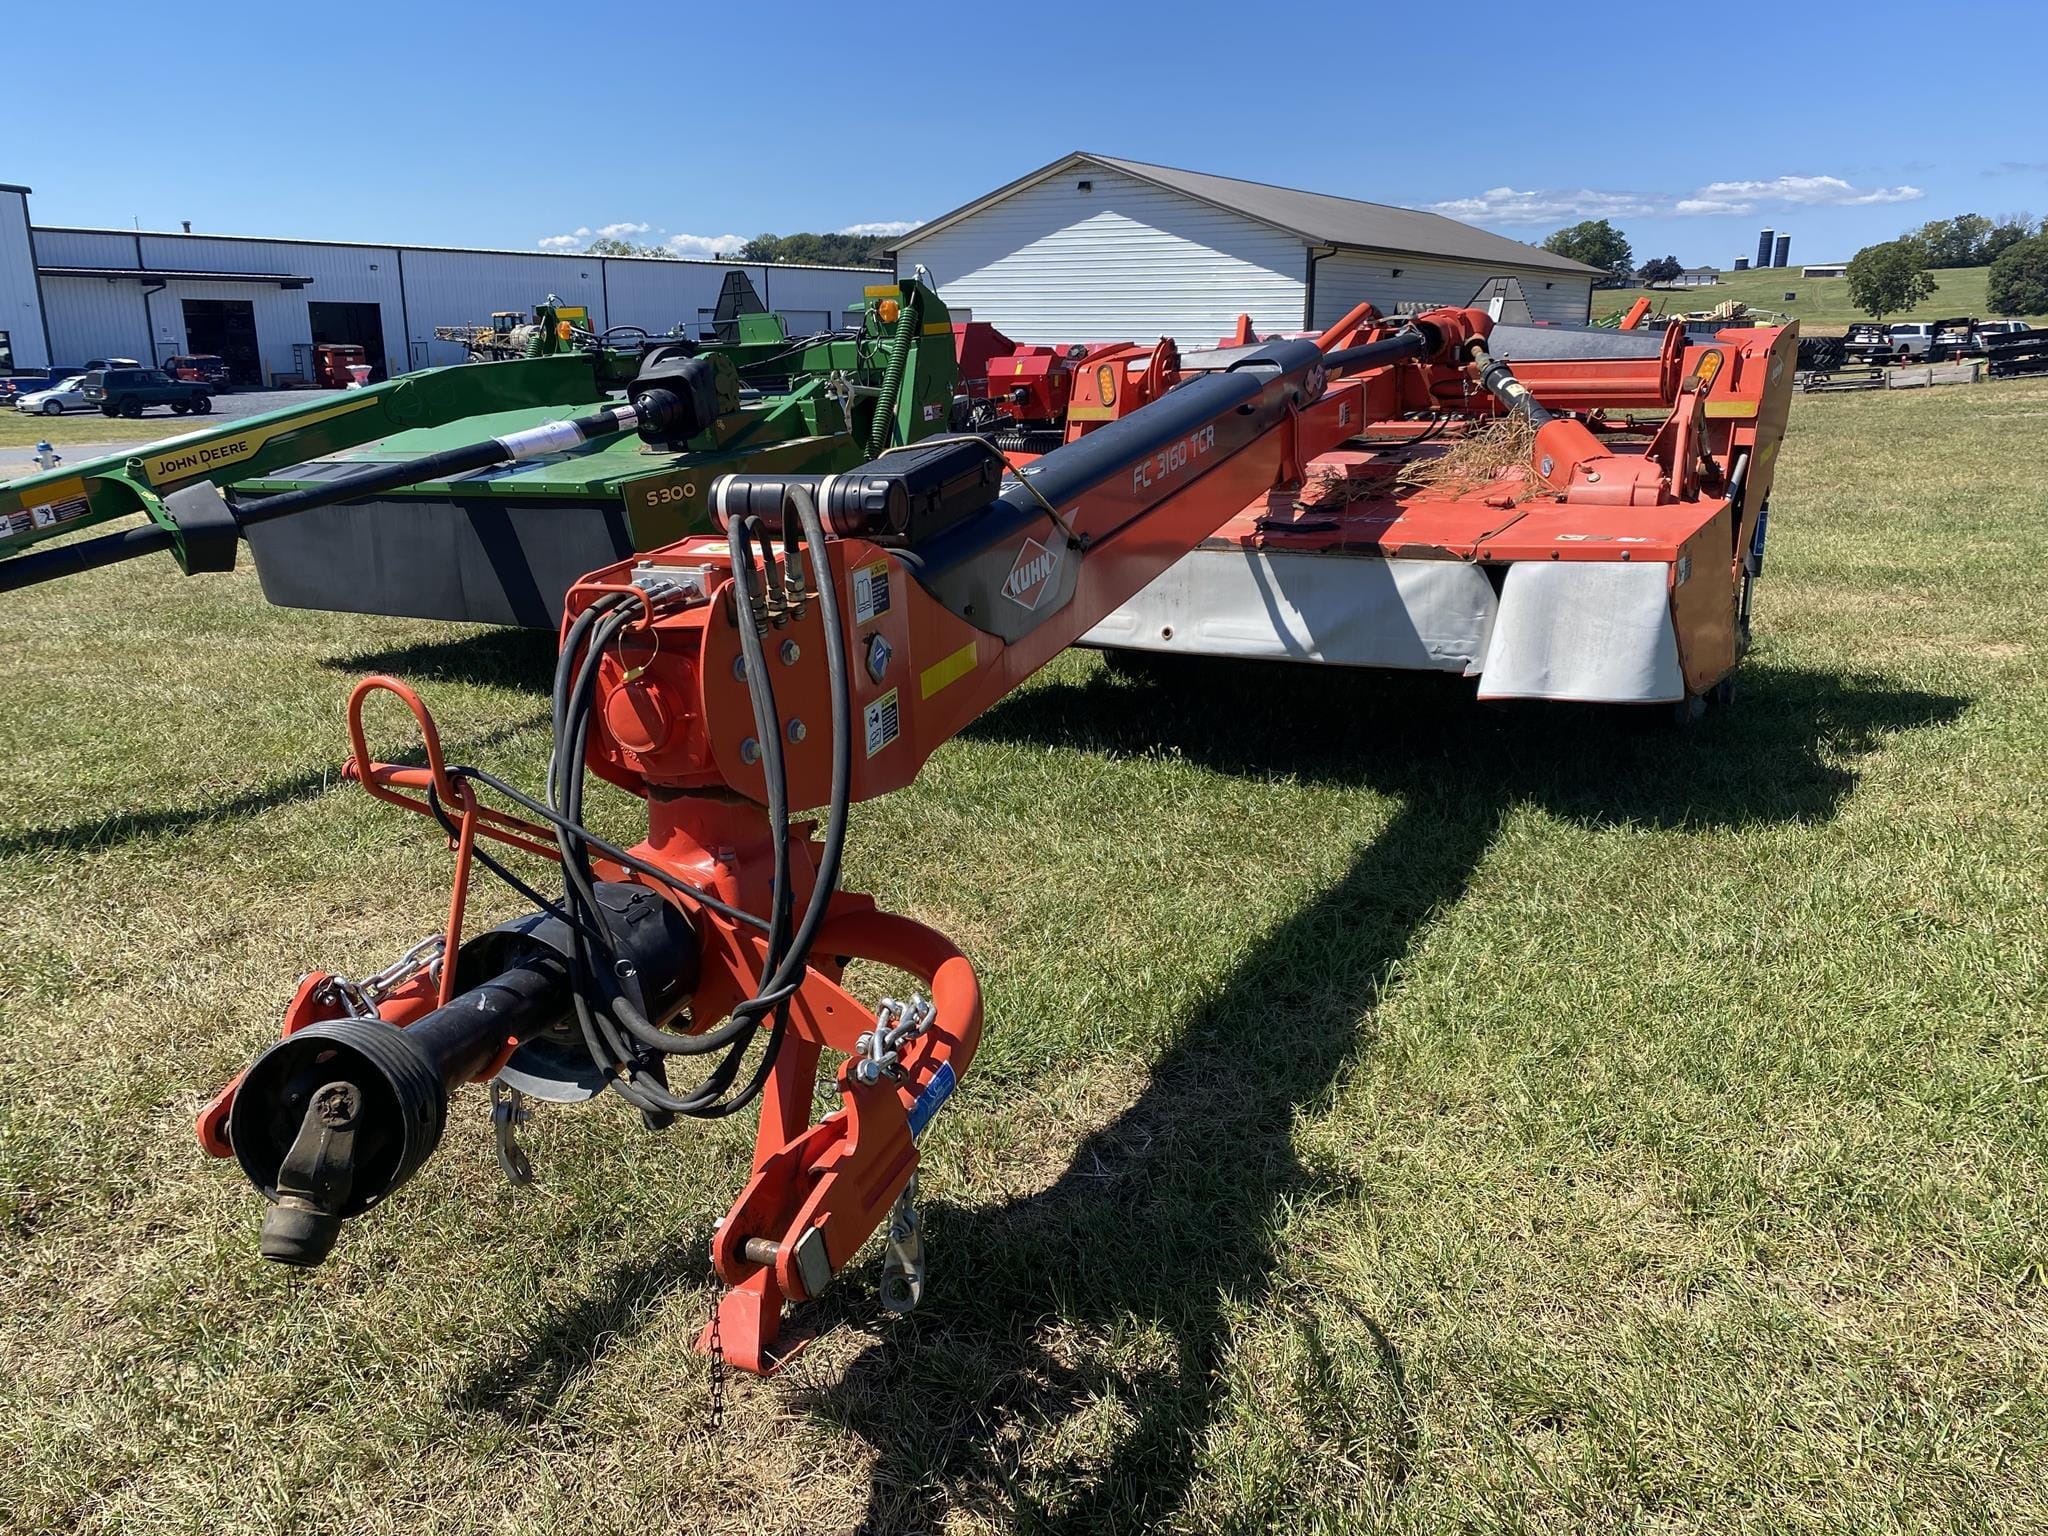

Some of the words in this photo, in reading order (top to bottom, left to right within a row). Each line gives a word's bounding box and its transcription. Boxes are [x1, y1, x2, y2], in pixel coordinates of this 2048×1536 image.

[158, 454, 198, 475] JOHN
[199, 441, 249, 463] DEERE
[1133, 460, 1152, 496] FC
[1157, 441, 1188, 480] 3160
[1191, 424, 1215, 458] TCR
[646, 482, 697, 506] S300
[1010, 551, 1051, 595] KUHN
